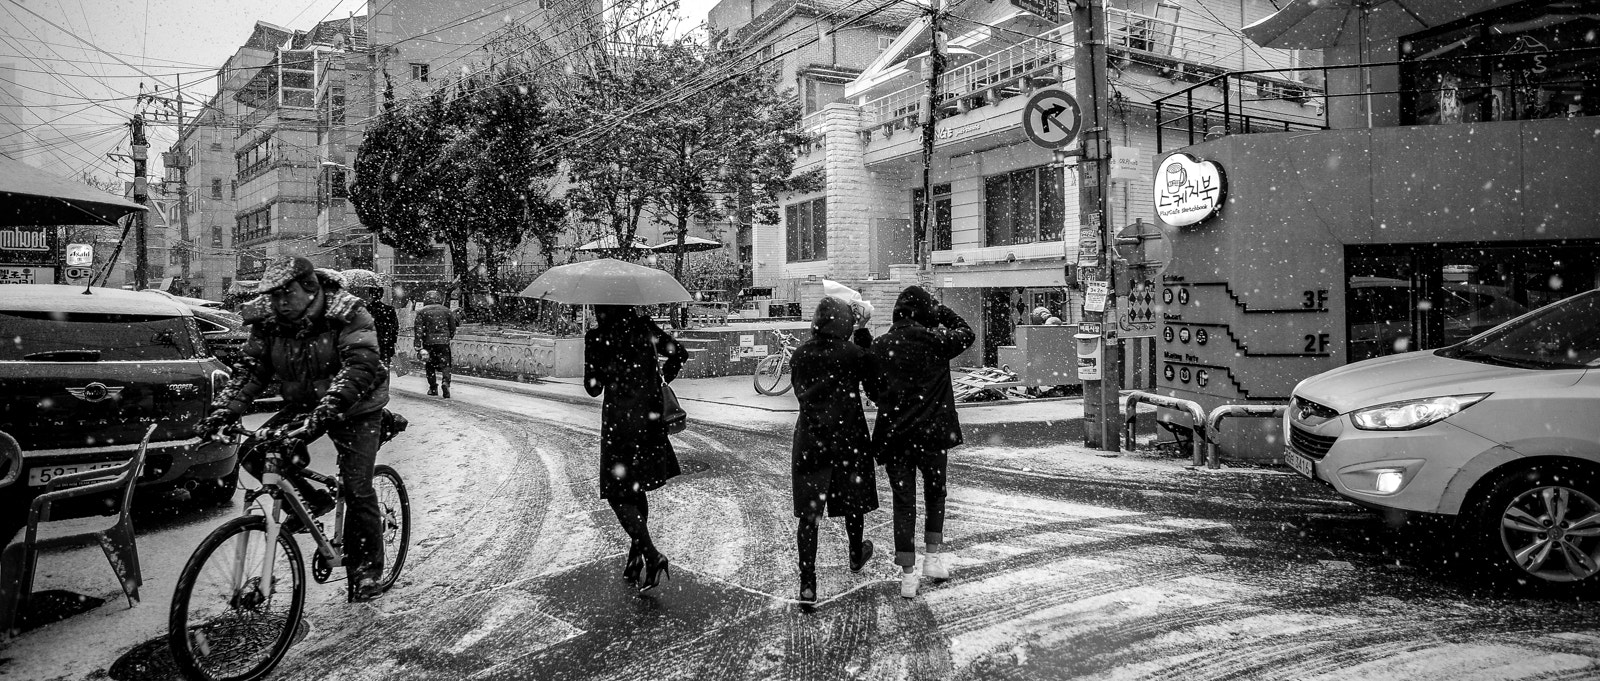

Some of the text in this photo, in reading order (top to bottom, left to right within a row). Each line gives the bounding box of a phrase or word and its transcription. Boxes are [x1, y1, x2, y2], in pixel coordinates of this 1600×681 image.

[917, 127, 954, 144] ONGE
[1159, 175, 1217, 207] 스케치북
[1303, 290, 1329, 308] 3F
[1304, 333, 1330, 352] 2F
